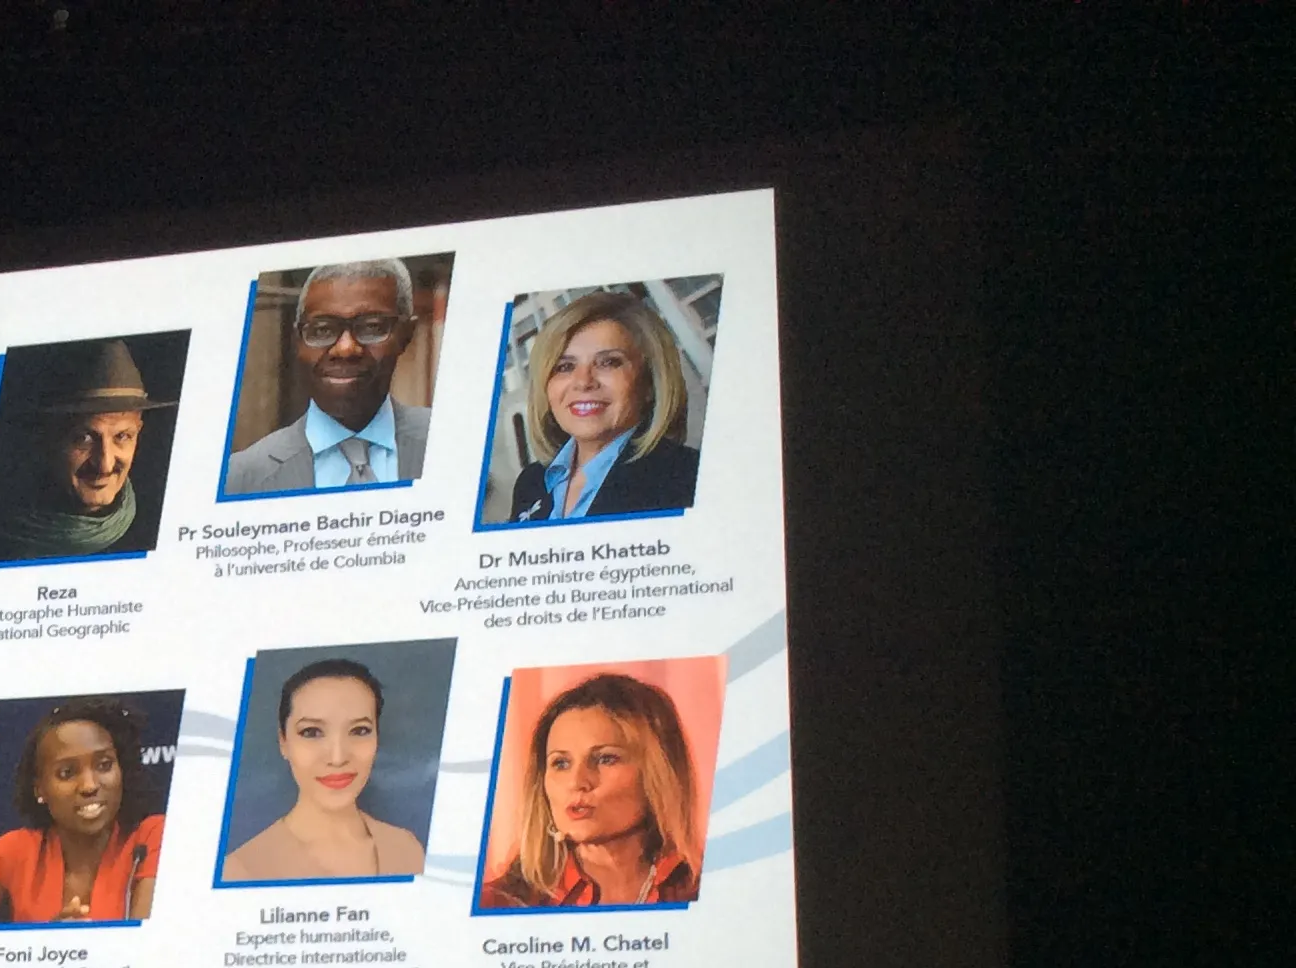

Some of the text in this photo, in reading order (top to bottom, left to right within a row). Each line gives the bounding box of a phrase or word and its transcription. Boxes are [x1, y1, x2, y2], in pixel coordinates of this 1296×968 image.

[178, 510, 445, 541] Pr Souleymane Bachir Diagne
[196, 530, 426, 561] Philosophe, Professeur émérite
[479, 539, 670, 569] Dr Mushira Khattab
[214, 551, 406, 577] à l'université de Columbia
[454, 564, 695, 591] Ancienne ministre égyptienne,
[37, 586, 77, 601] Reza
[419, 577, 733, 613] Vice-Présidente du Bureau international
[67, 602, 143, 617] Humaniste
[484, 604, 666, 629] des droits de l'Enfance
[46, 620, 130, 639] Geographic
[260, 906, 369, 924] Lilianne Fan
[236, 928, 394, 950] Experte humanitaire,
[482, 932, 669, 955] Caroline M. Chatel
[37, 946, 88, 965] Joyce
[224, 947, 407, 966] Directrice internationale
